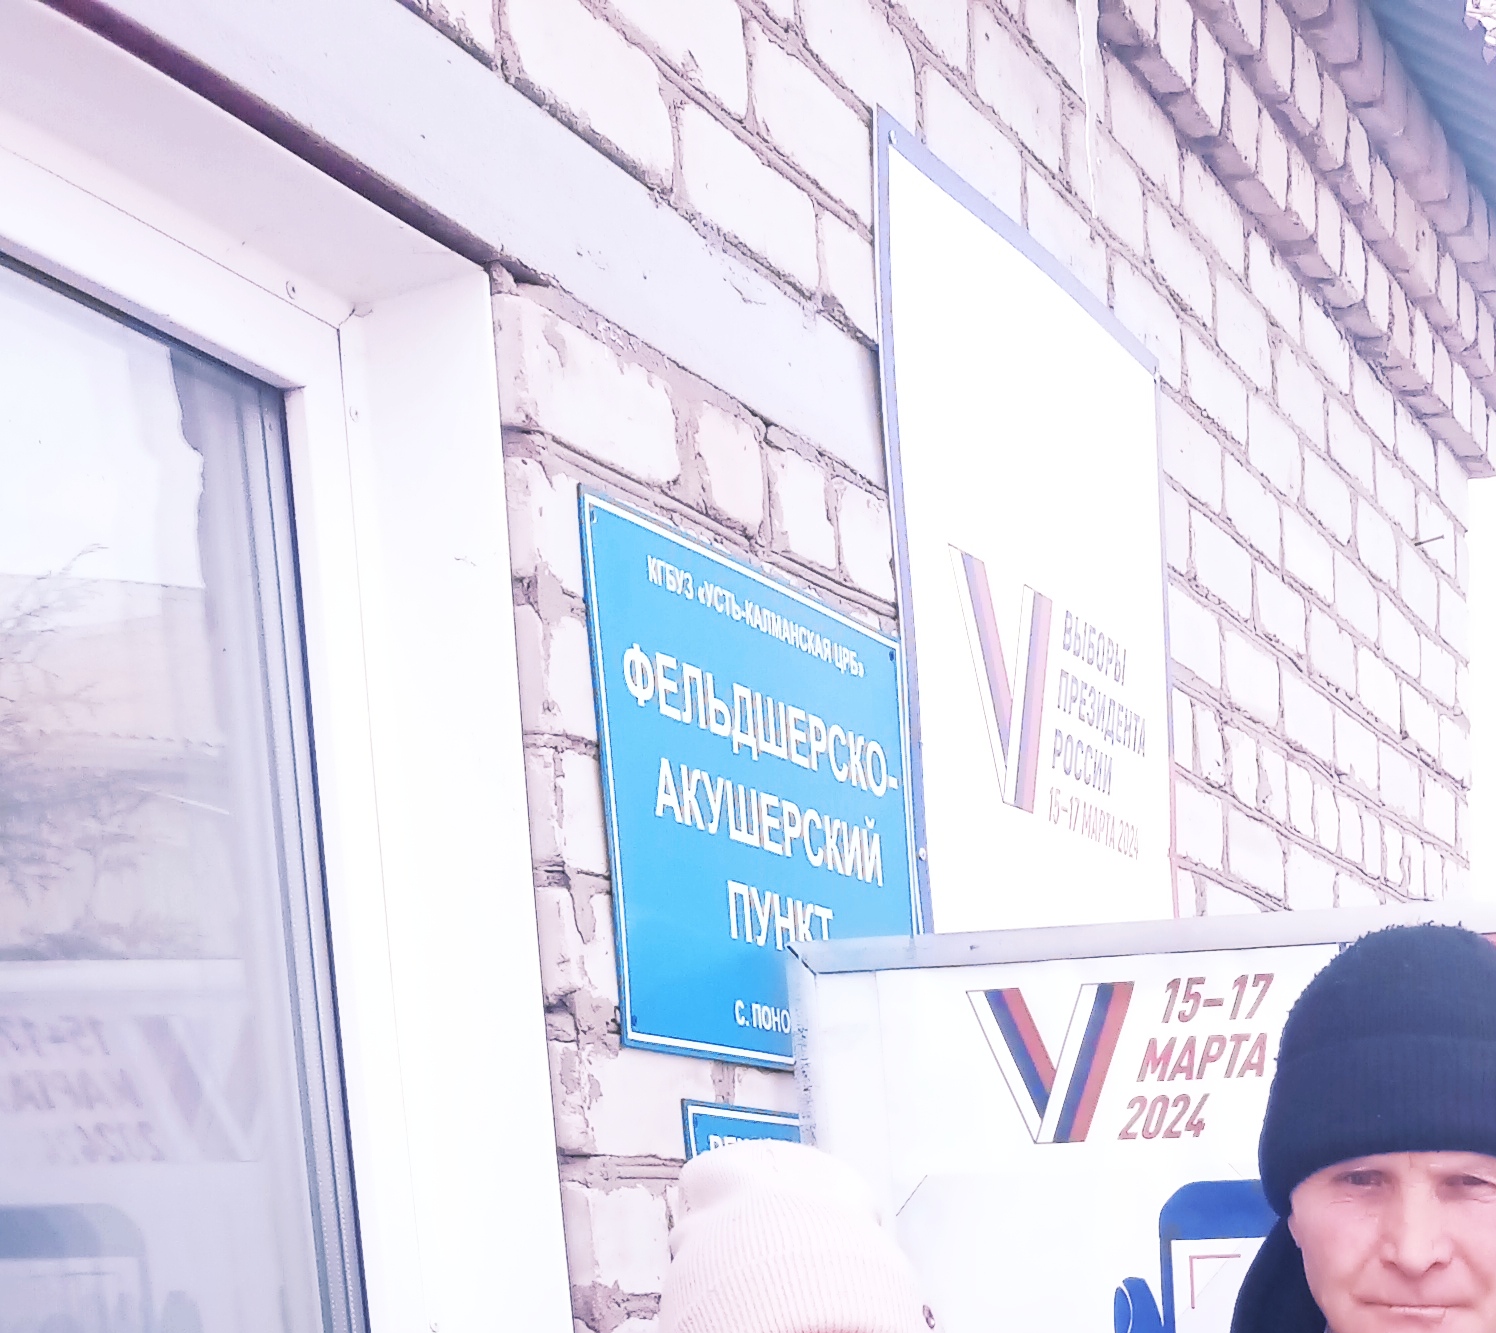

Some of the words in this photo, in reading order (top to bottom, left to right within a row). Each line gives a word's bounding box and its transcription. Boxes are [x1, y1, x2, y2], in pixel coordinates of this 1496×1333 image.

[647, 554, 694, 600] КГБУЗ
[698, 580, 832, 664] «УСТЬ-КАЛМАНСКАЯ
[834, 642, 865, 679] ЦРБ»
[1063, 609, 1126, 687] ВЫБОРЫ
[623, 642, 898, 798] ФЕЛЬДШЕРСКО-
[1057, 668, 1146, 758] ПРЕЗИДЕНТА
[1052, 728, 1113, 796] РОССИИ
[655, 757, 884, 888] АКУШЕРСКИЙ
[1081, 801, 1115, 850] МАРТА
[1118, 820, 1139, 861] 2024
[727, 879, 834, 951] ПУНКТ
[1136, 1032, 1268, 1083] МАРТА
[1117, 1092, 1210, 1141] 2024
